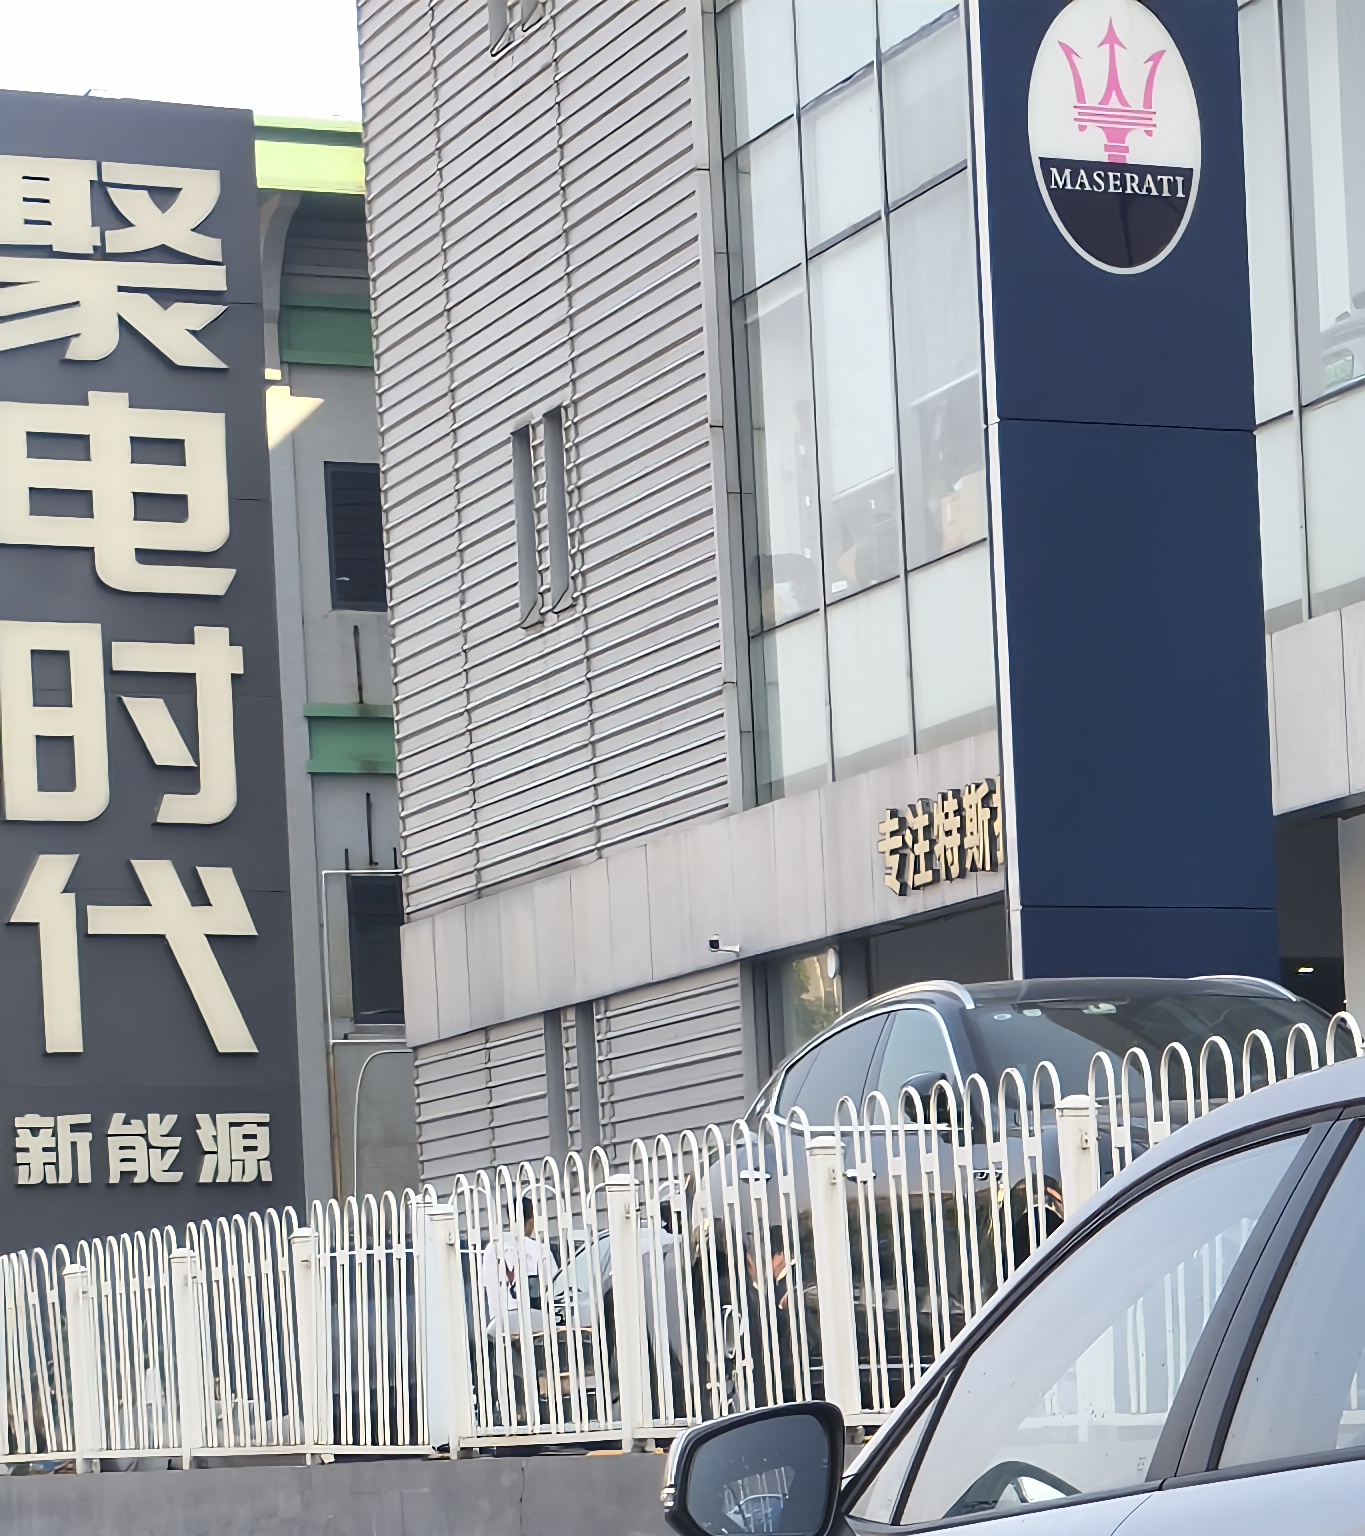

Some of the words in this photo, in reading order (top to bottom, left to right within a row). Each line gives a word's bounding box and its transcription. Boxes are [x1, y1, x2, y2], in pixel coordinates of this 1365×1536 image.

[1050, 167, 1186, 198] MASERATI
[0, 153, 259, 1054] 聚电时代
[14, 1112, 273, 1185] 新能源
